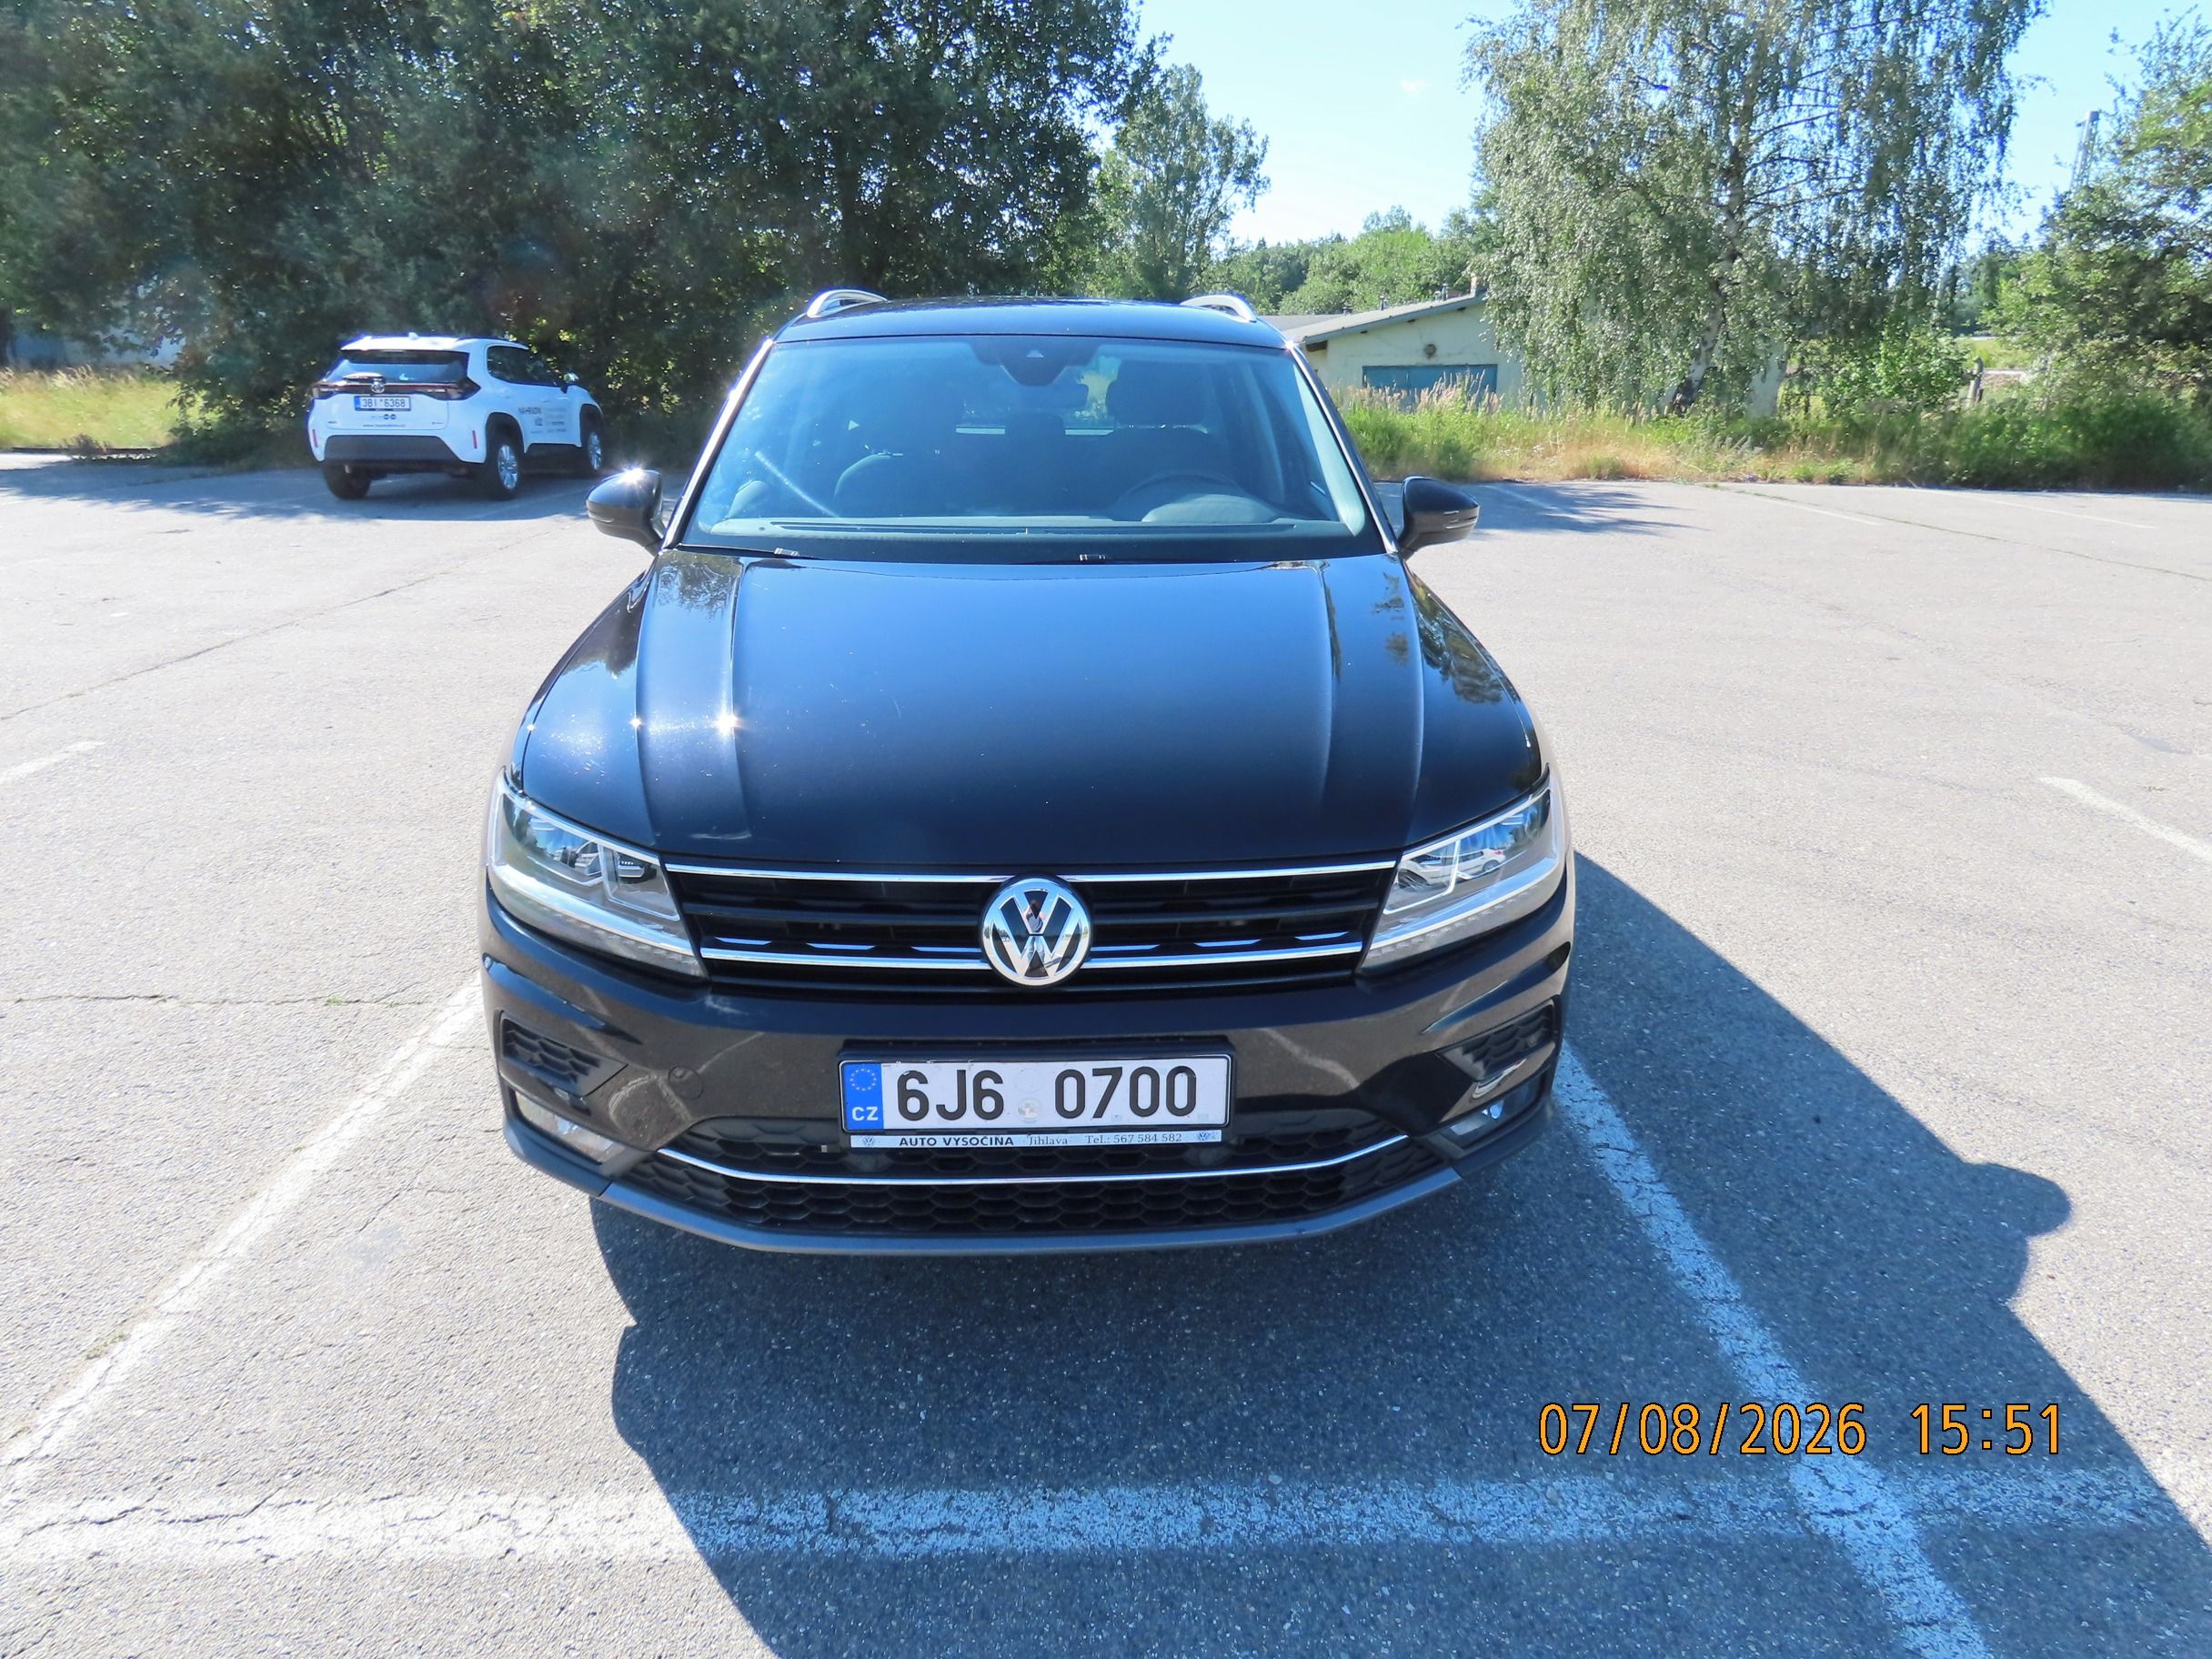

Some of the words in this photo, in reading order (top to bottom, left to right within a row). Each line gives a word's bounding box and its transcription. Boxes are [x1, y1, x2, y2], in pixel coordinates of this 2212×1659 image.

[897, 1070, 1004, 1121] 6J6
[1055, 1065, 1197, 1120] 0700
[851, 1106, 879, 1121] CZ
[899, 1136, 938, 1147] AUTO
[942, 1135, 1014, 1146] VYSOČINA
[1029, 1135, 1069, 1146] Jihlava
[1113, 1134, 1134, 1143] 567
[1137, 1133, 1158, 1142] 584
[1161, 1132, 1182, 1142] 582
